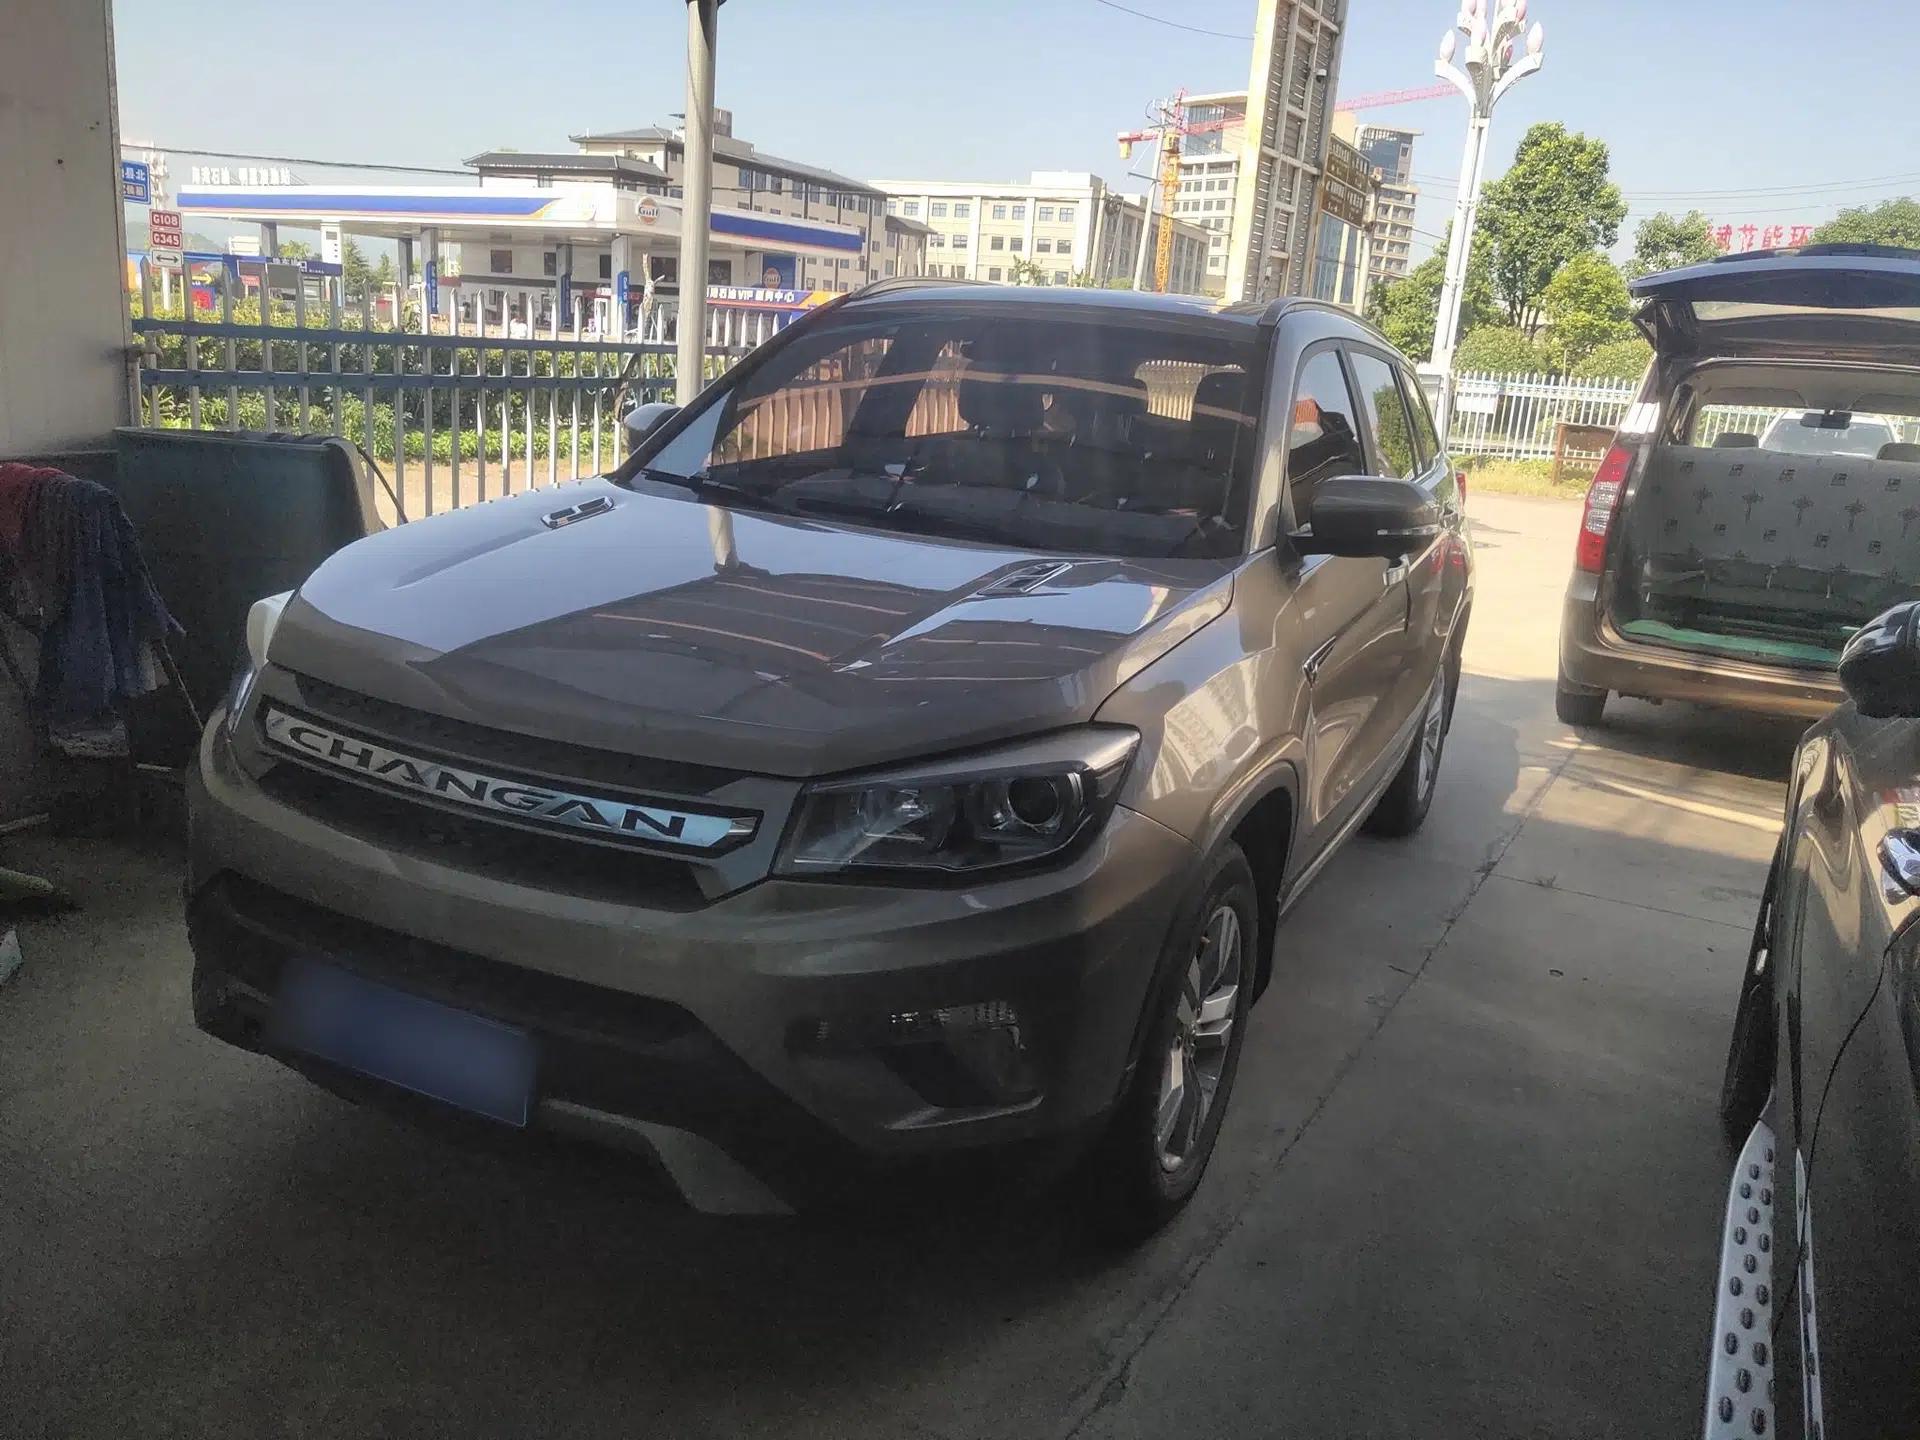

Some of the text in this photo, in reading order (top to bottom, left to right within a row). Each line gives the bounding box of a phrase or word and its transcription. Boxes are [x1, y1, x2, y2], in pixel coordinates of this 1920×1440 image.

[122, 167, 146, 181] 县北
[638, 206, 659, 217] Gulf
[152, 213, 178, 226] G108
[152, 234, 179, 247] G345
[288, 725, 687, 839] CHANGAN
